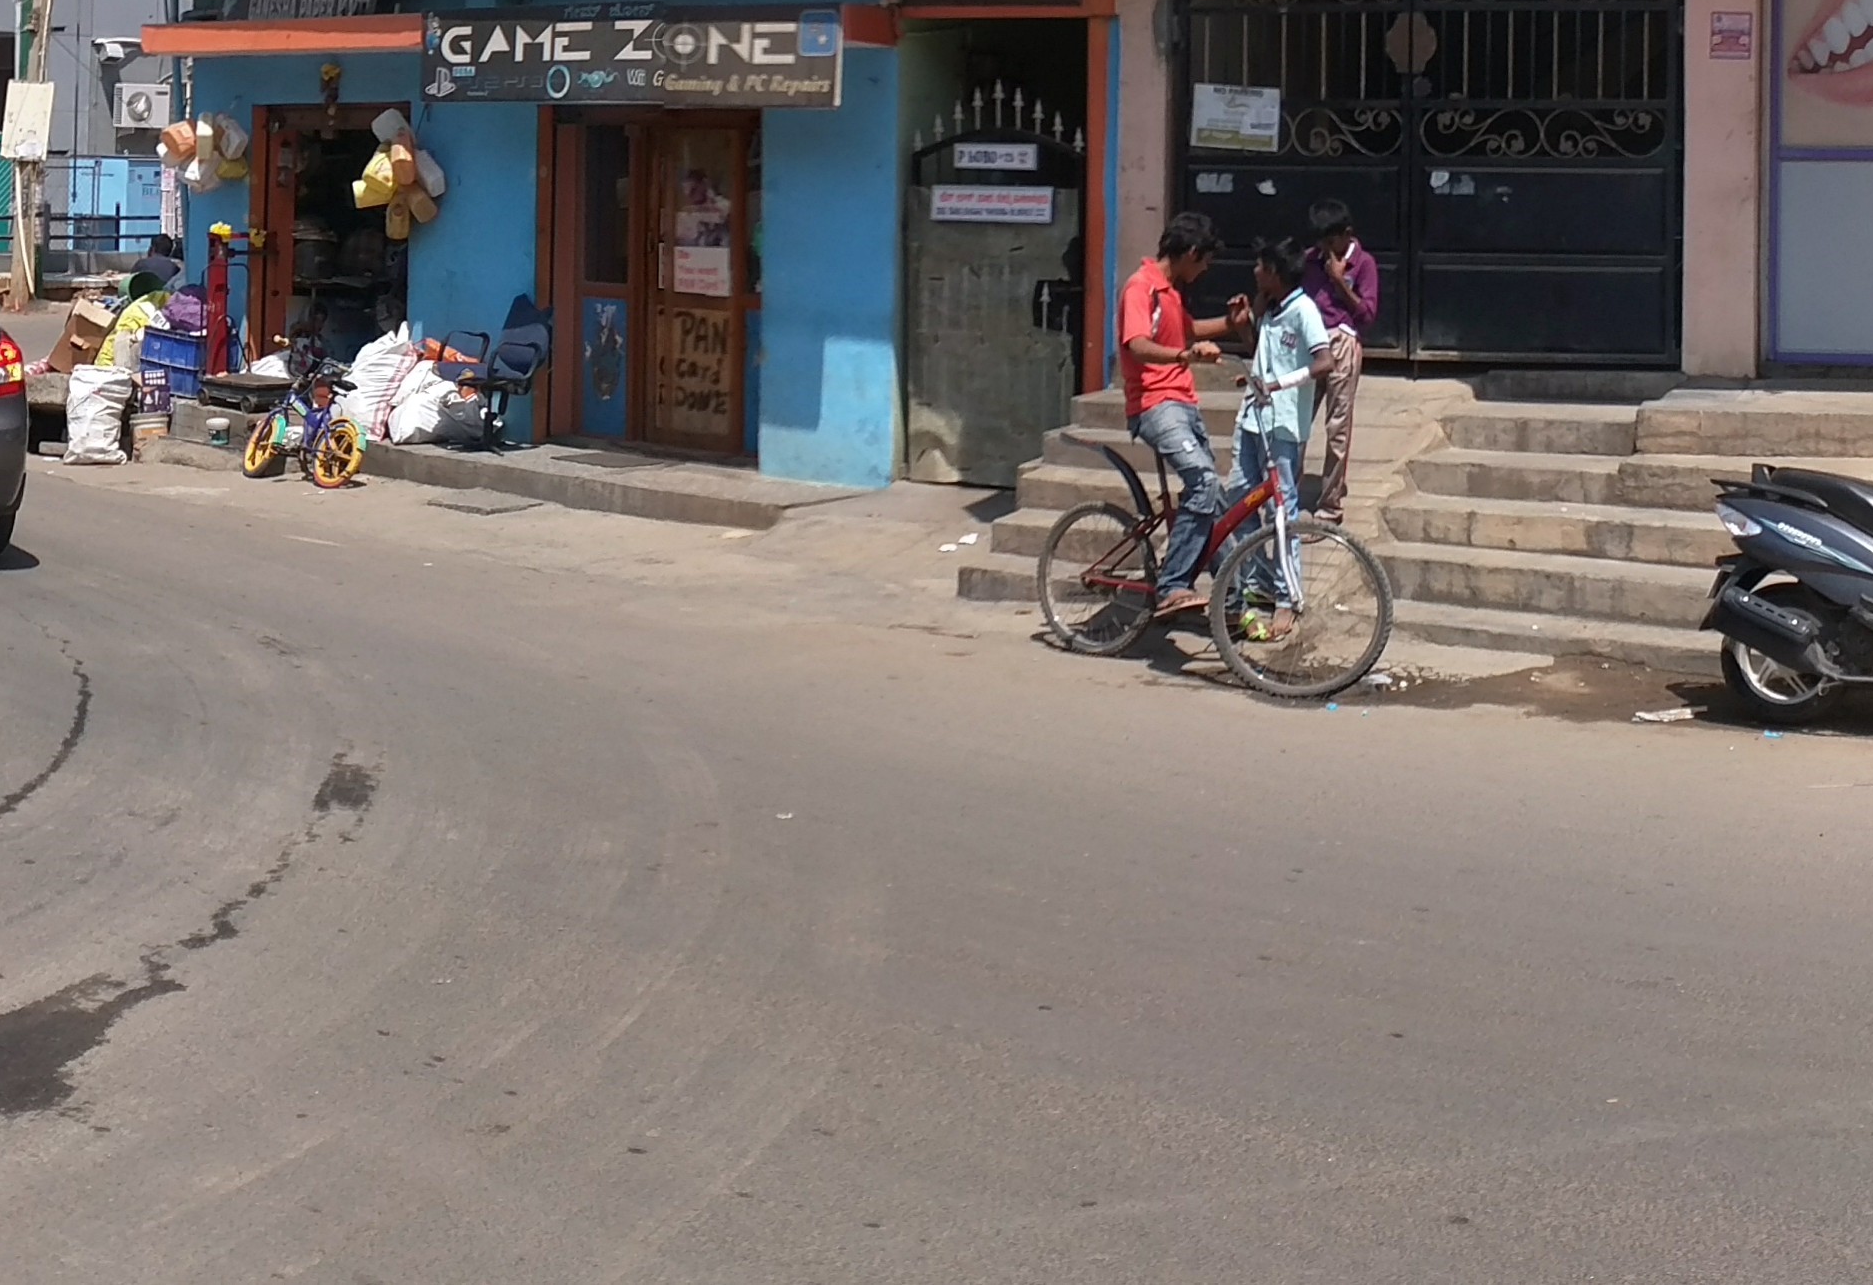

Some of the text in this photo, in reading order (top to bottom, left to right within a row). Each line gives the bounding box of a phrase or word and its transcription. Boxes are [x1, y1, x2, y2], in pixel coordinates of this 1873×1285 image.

[440, 20, 594, 63] GAME
[664, 74, 833, 96] Gaming & PC Repairs
